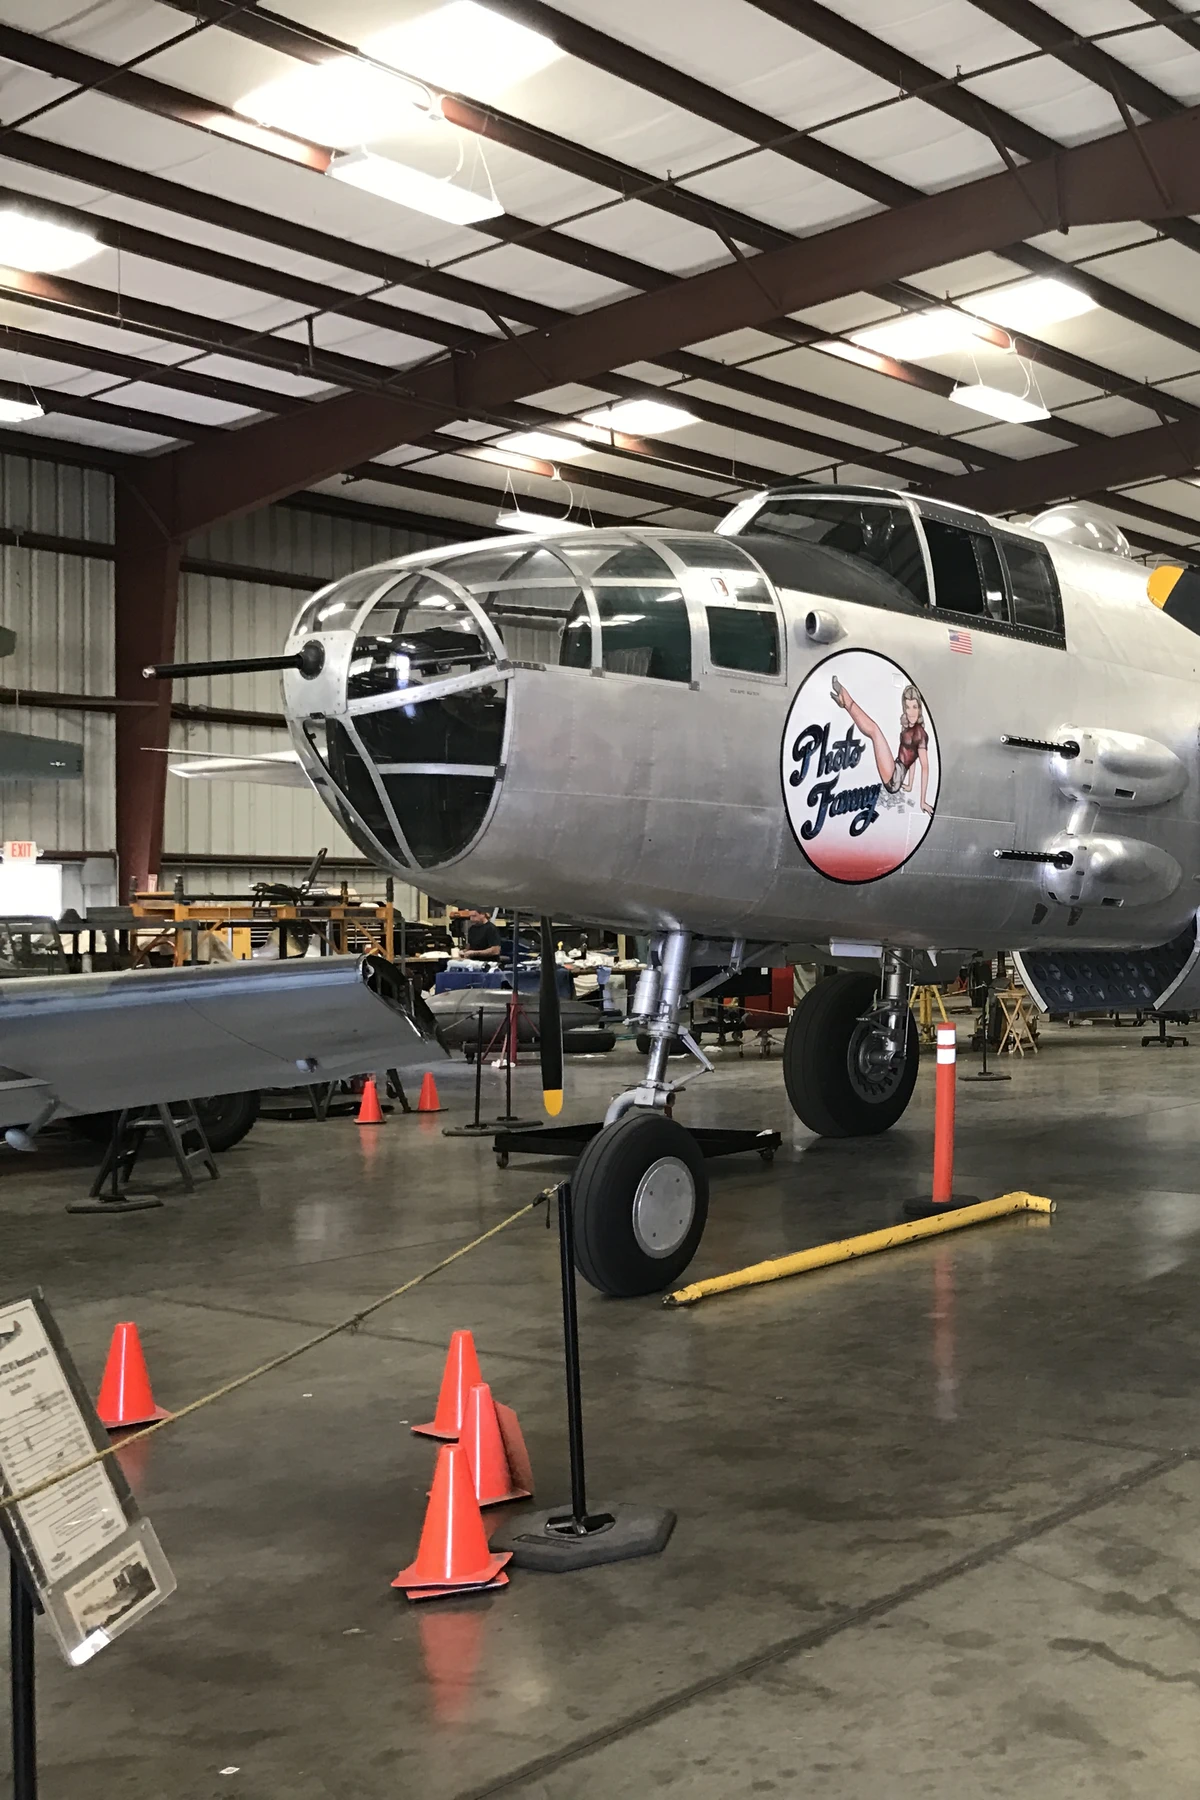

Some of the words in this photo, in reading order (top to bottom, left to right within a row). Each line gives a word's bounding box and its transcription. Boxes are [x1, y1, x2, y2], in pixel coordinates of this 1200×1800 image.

[789, 722, 866, 787] Photo
[800, 773, 883, 841] Fanny
[11, 843, 32, 857] EXIT
